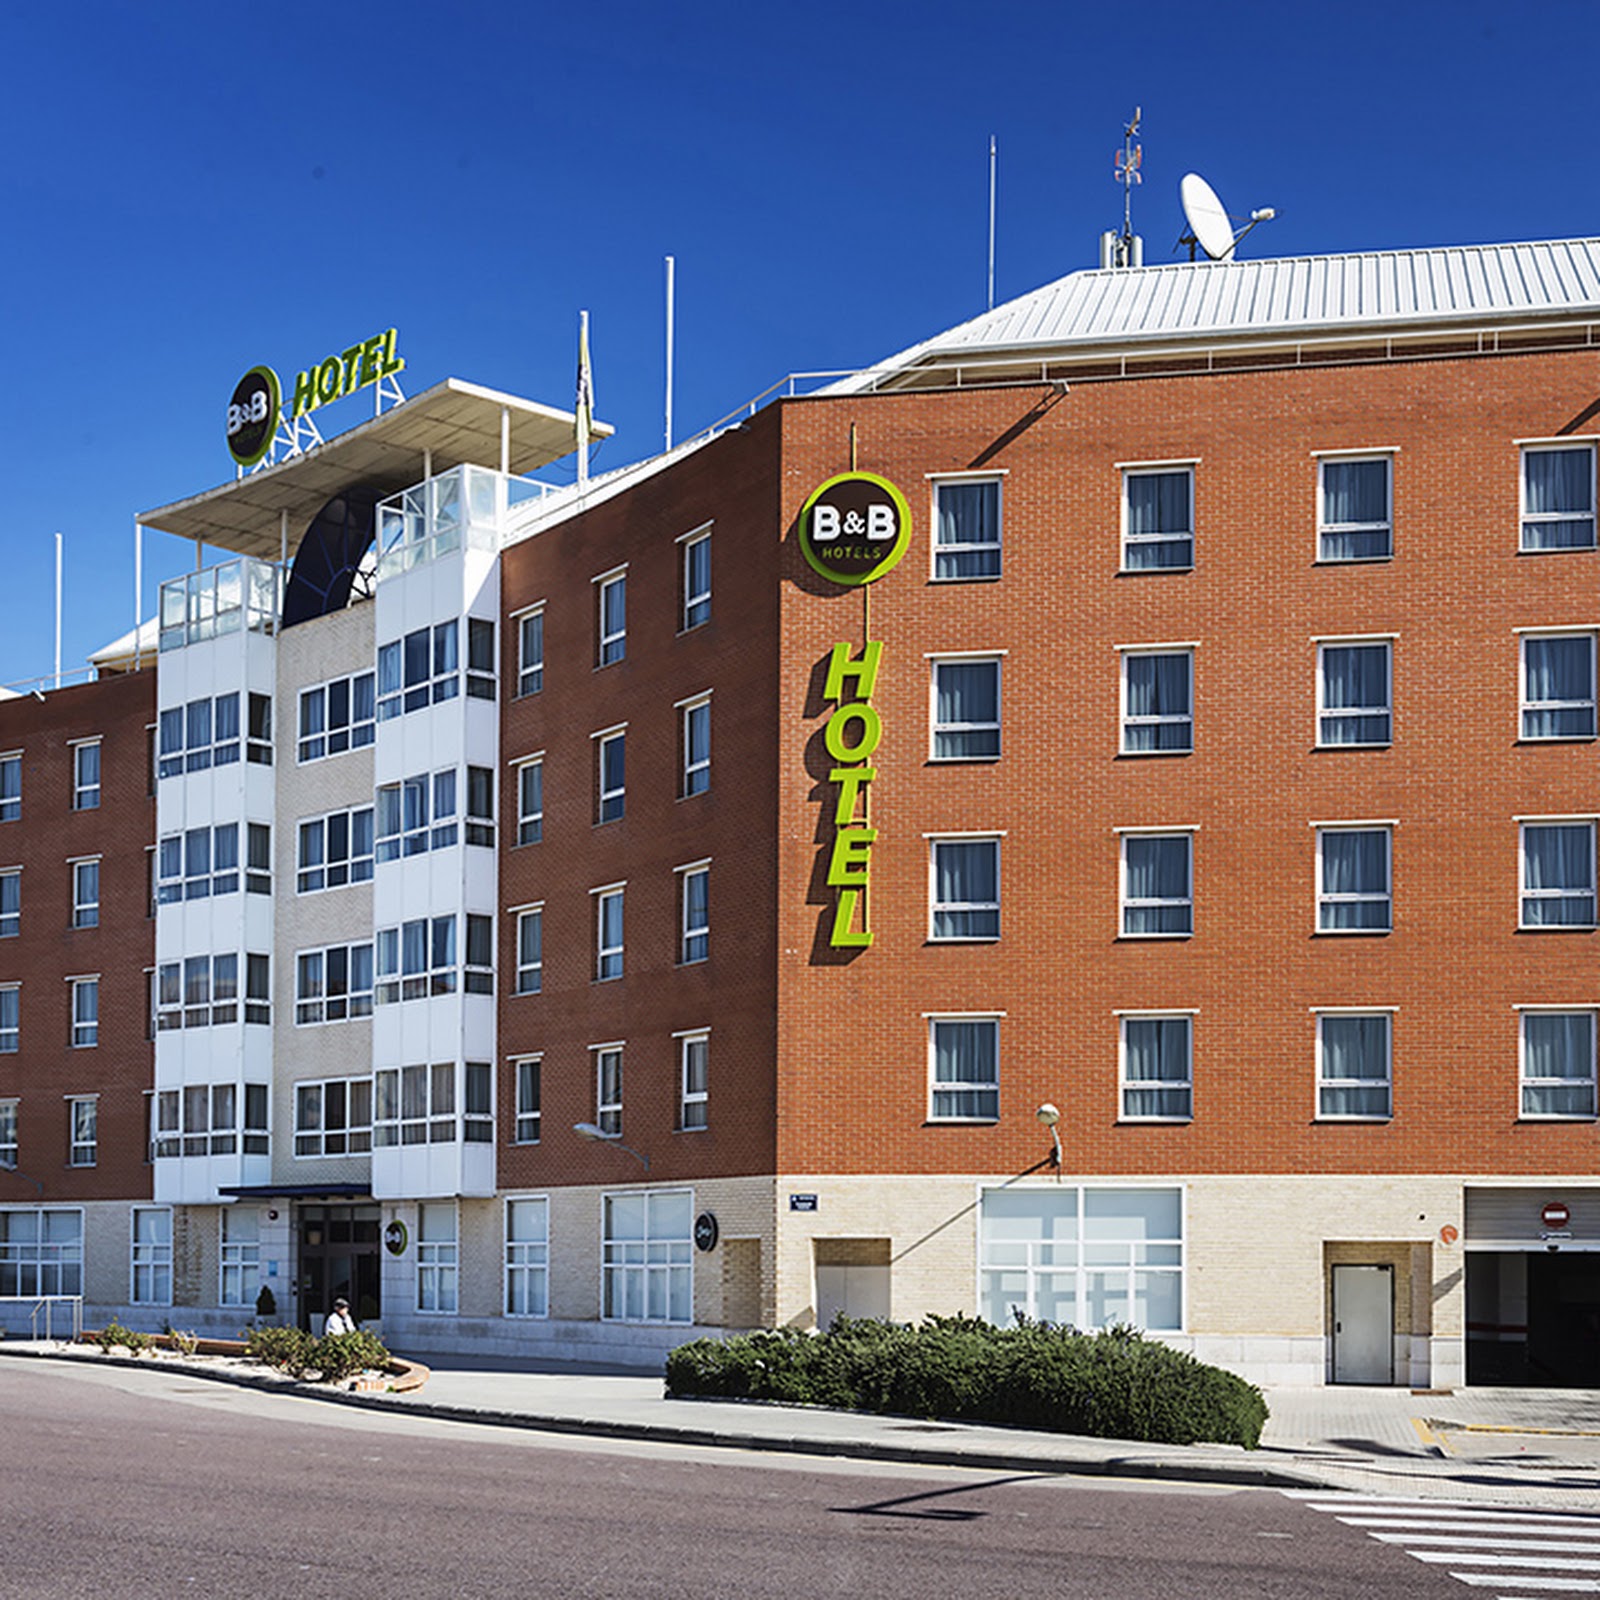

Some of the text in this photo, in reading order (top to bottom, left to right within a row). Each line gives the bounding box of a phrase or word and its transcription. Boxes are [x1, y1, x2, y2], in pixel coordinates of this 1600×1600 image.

[293, 328, 405, 418] HOTEL
[227, 390, 268, 435] B&B
[813, 504, 896, 541] B&B
[822, 547, 881, 559] HOTELS
[823, 641, 883, 947] HOTEL
